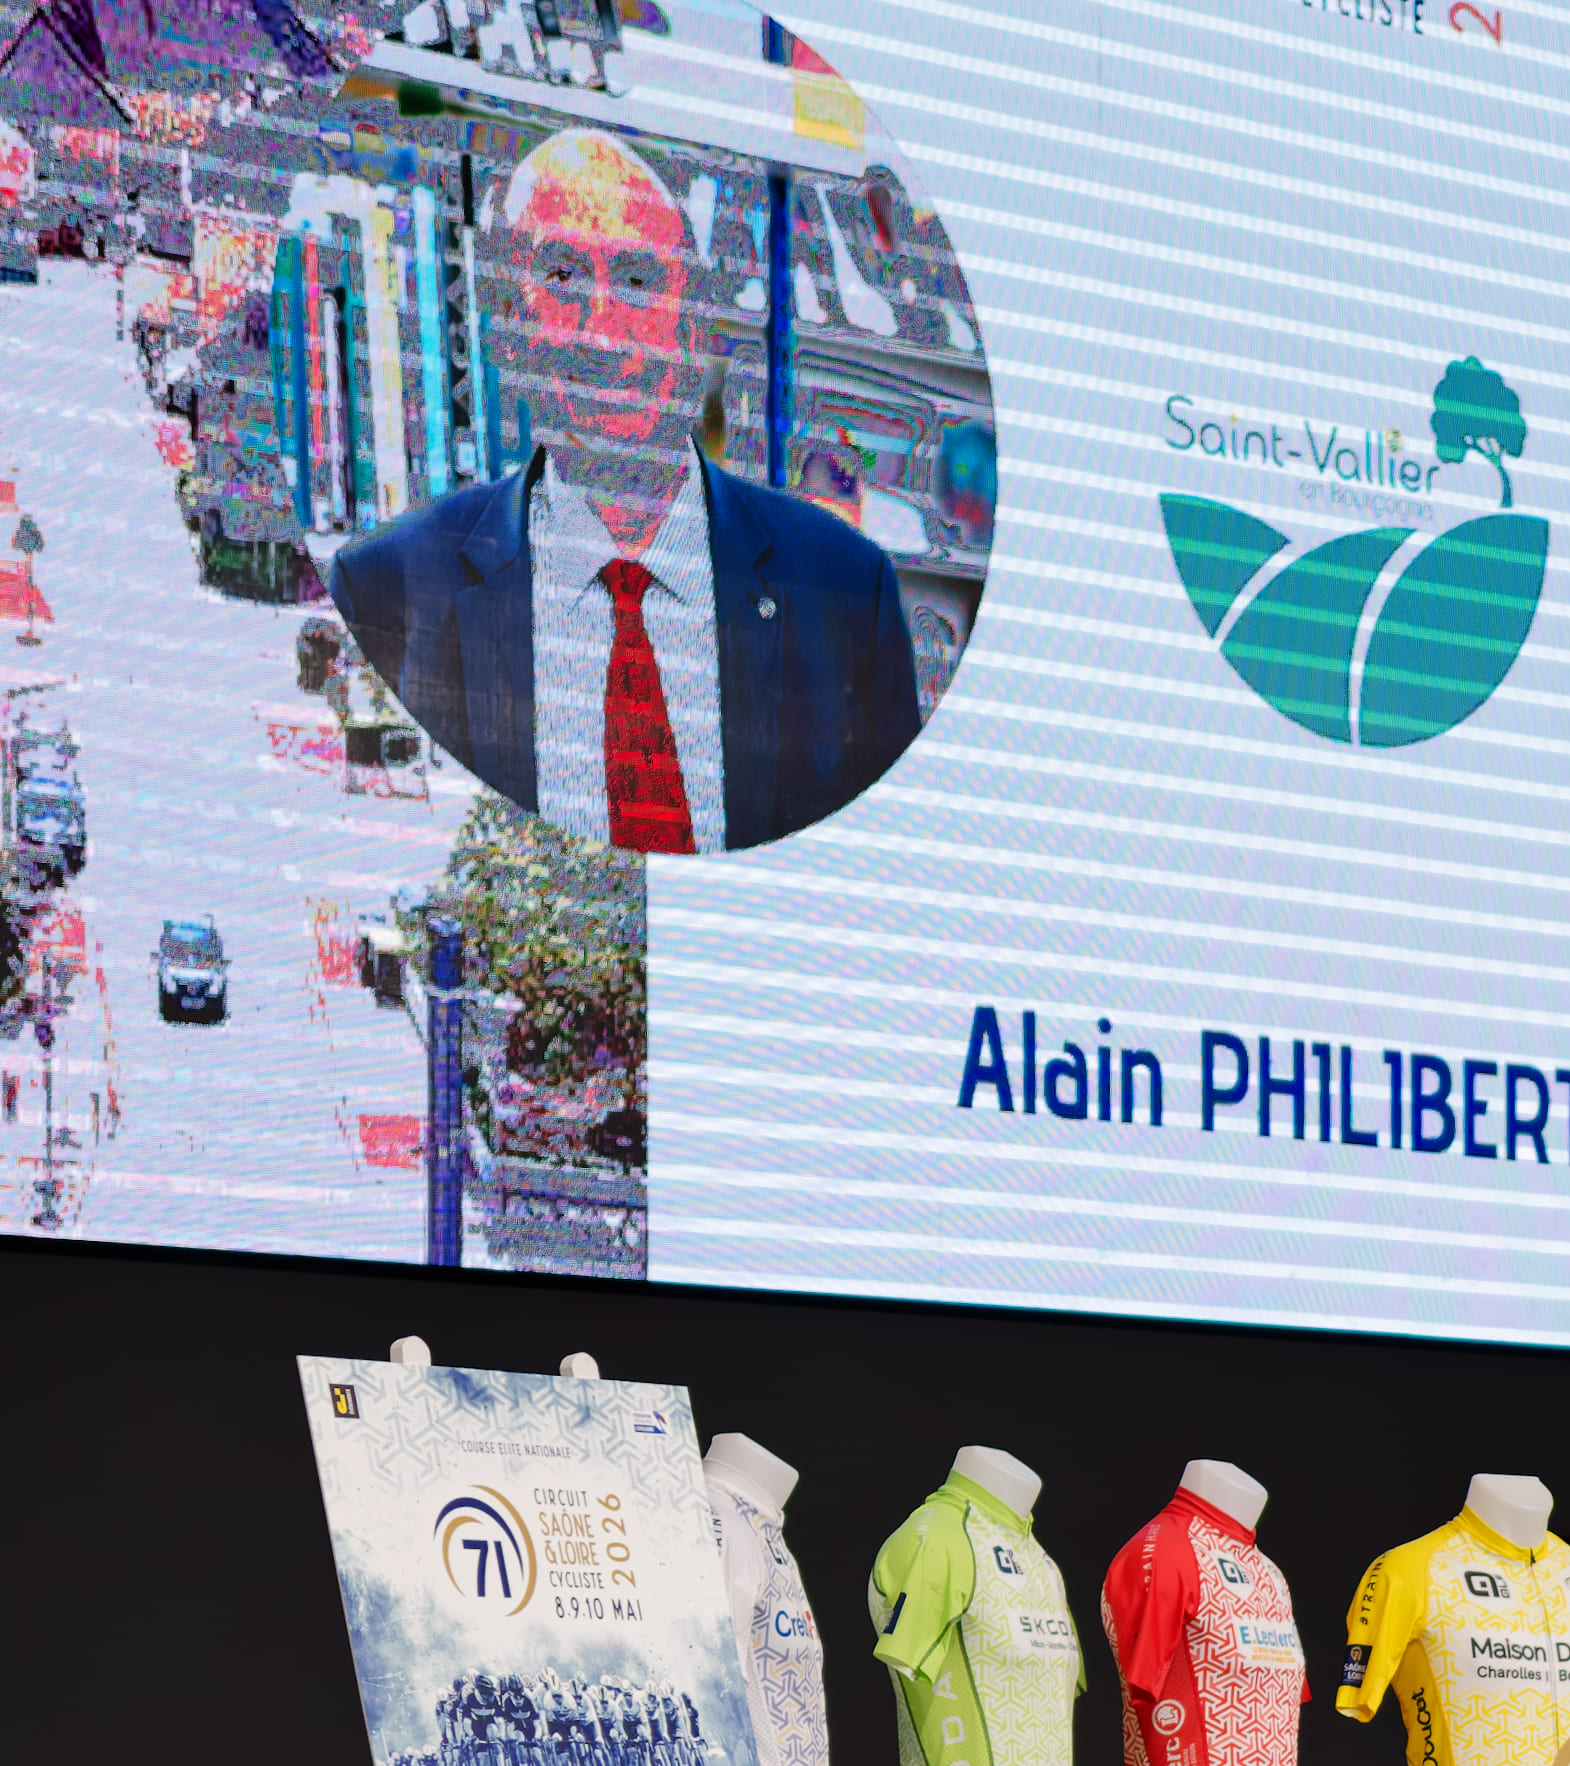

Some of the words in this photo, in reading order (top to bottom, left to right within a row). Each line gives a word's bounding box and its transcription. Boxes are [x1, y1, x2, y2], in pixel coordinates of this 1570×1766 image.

[1305, 0, 1424, 35] LISTE
[1164, 394, 1440, 493] Saint-Vallier
[956, 1005, 1163, 1127] Alain
[462, 1440, 496, 1455] COURSE
[498, 1442, 522, 1456] ELITE
[525, 1444, 571, 1460] NATIONALE
[533, 1487, 588, 1507] CIRCUIT
[538, 1507, 595, 1539] SAÔNE
[557, 1540, 600, 1566] LOIRE
[596, 1493, 637, 1588] 2026
[462, 1539, 512, 1599] 71
[549, 1570, 605, 1589] CYCLISTE
[555, 1596, 604, 1620] 8.9.10
[611, 1598, 643, 1622] MAI
[1019, 1616, 1076, 1637] SKOD
[1239, 1625, 1296, 1648] E.Leclerc
[1470, 1637, 1546, 1663] Maison
[1477, 1665, 1542, 1681] Charolles
